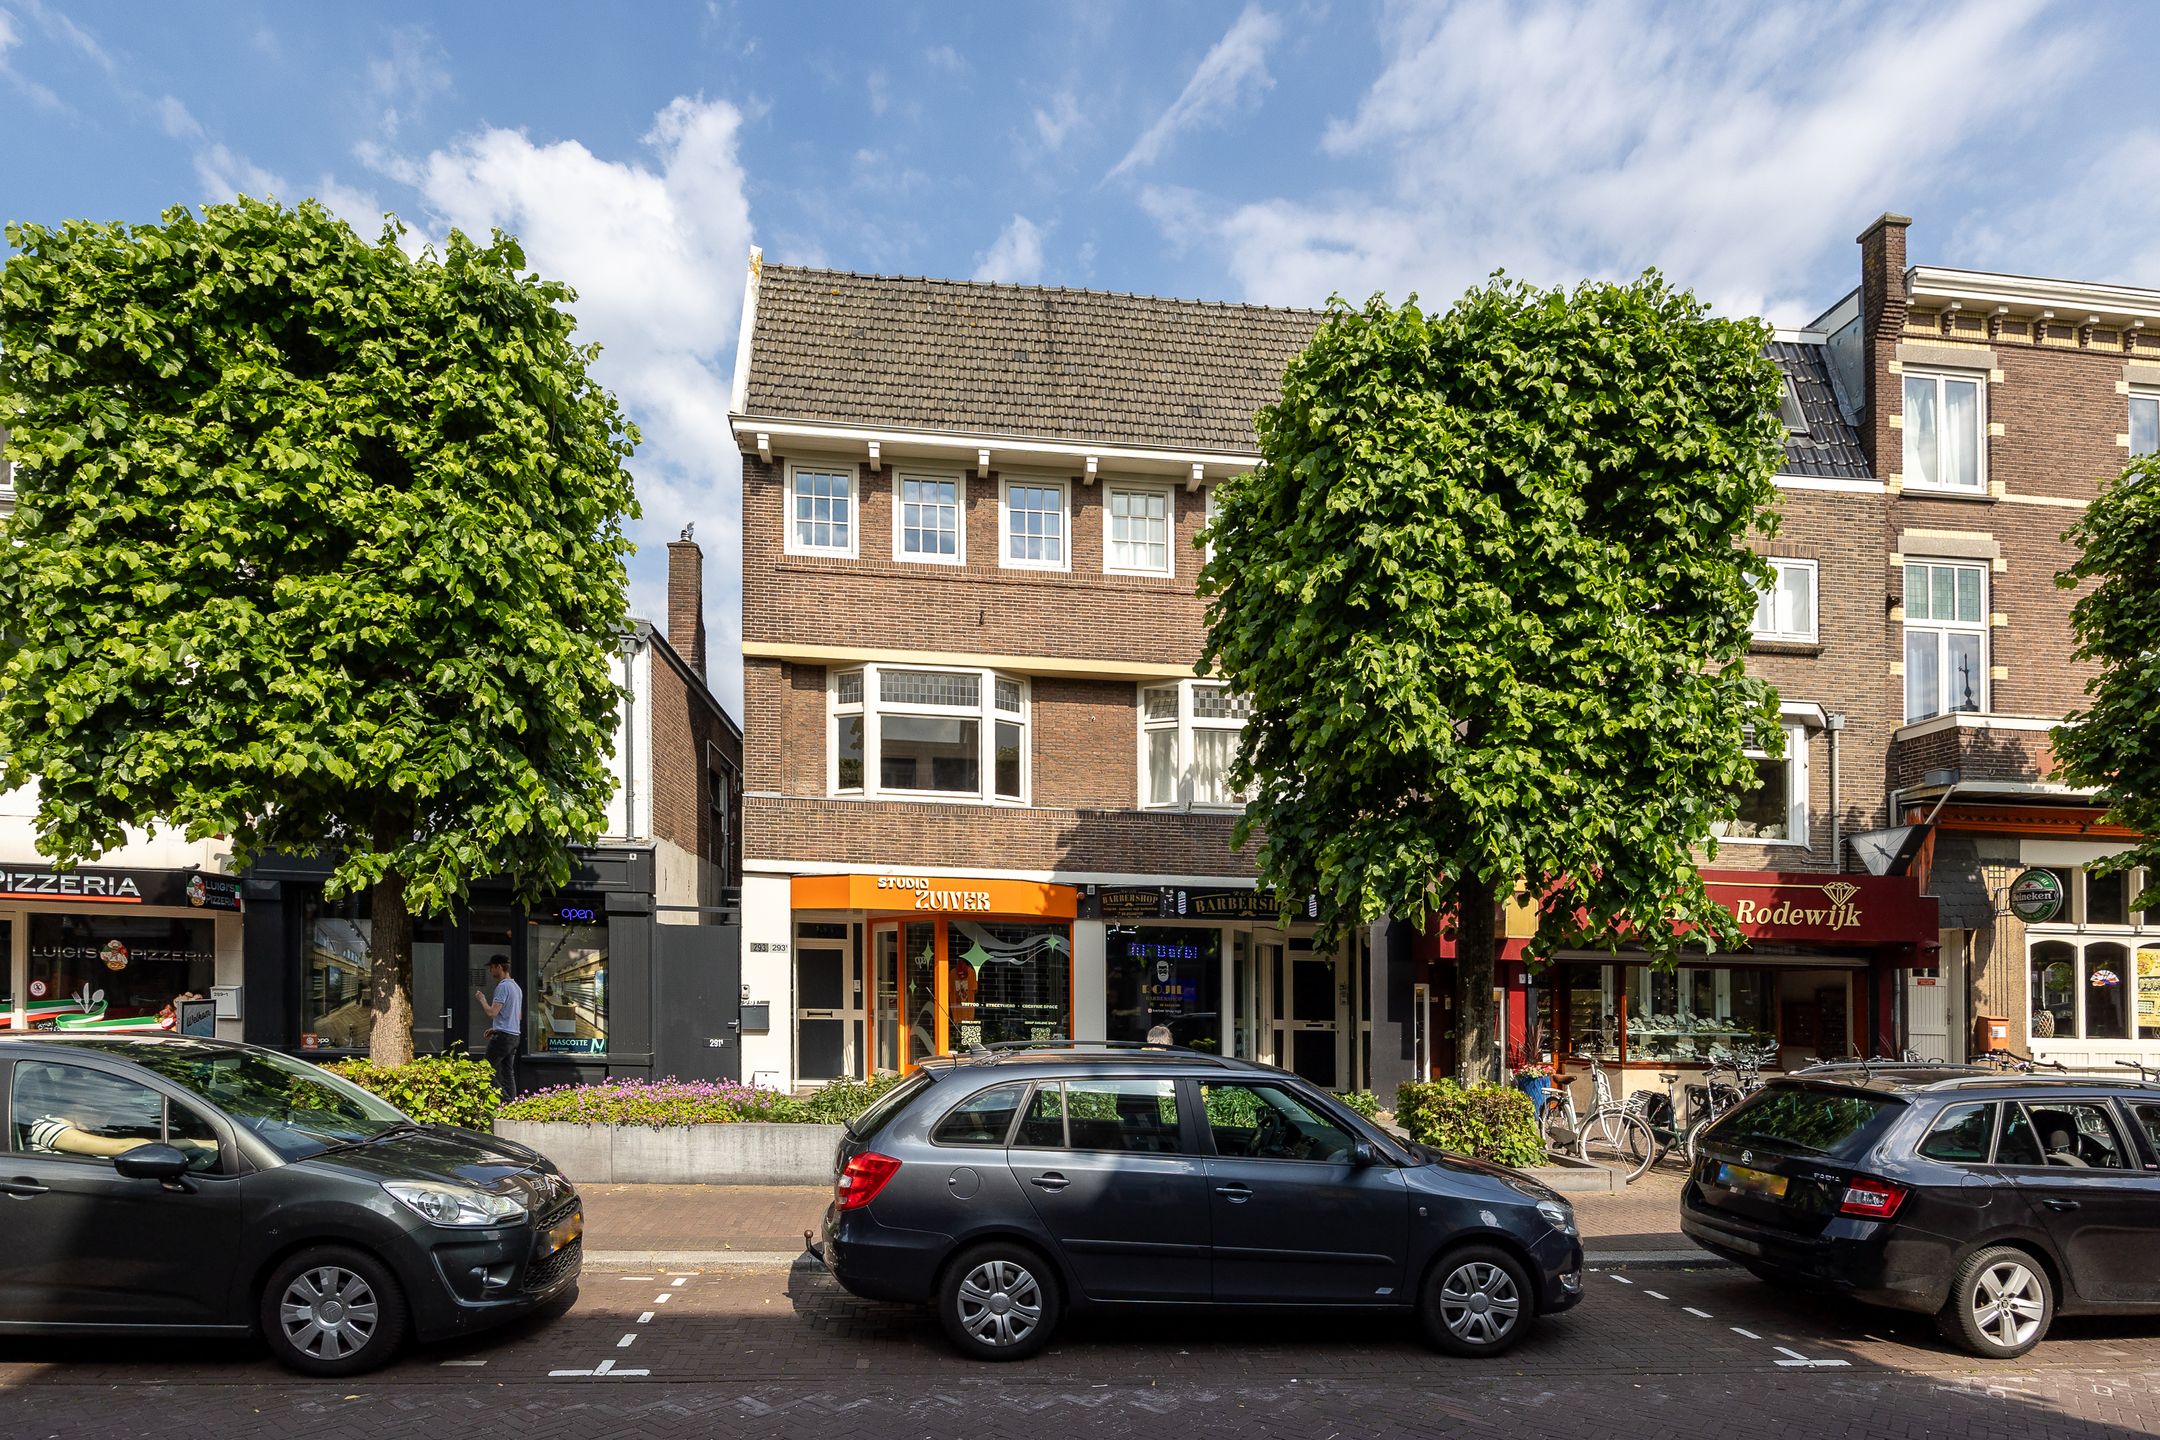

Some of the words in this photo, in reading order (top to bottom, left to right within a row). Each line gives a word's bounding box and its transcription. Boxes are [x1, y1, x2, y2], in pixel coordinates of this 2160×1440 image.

[877, 877, 929, 890] STUDIO
[915, 889, 991, 911] ZUIVER
[1102, 893, 1158, 904] BARBERSHOP
[1195, 895, 1290, 913] BARBERSH
[561, 908, 594, 920] open
[1736, 899, 1862, 931] Rodewijk
[32, 946, 97, 959] LUIGI'S
[130, 949, 213, 962] PIZZERIA
[753, 943, 766, 952] 293
